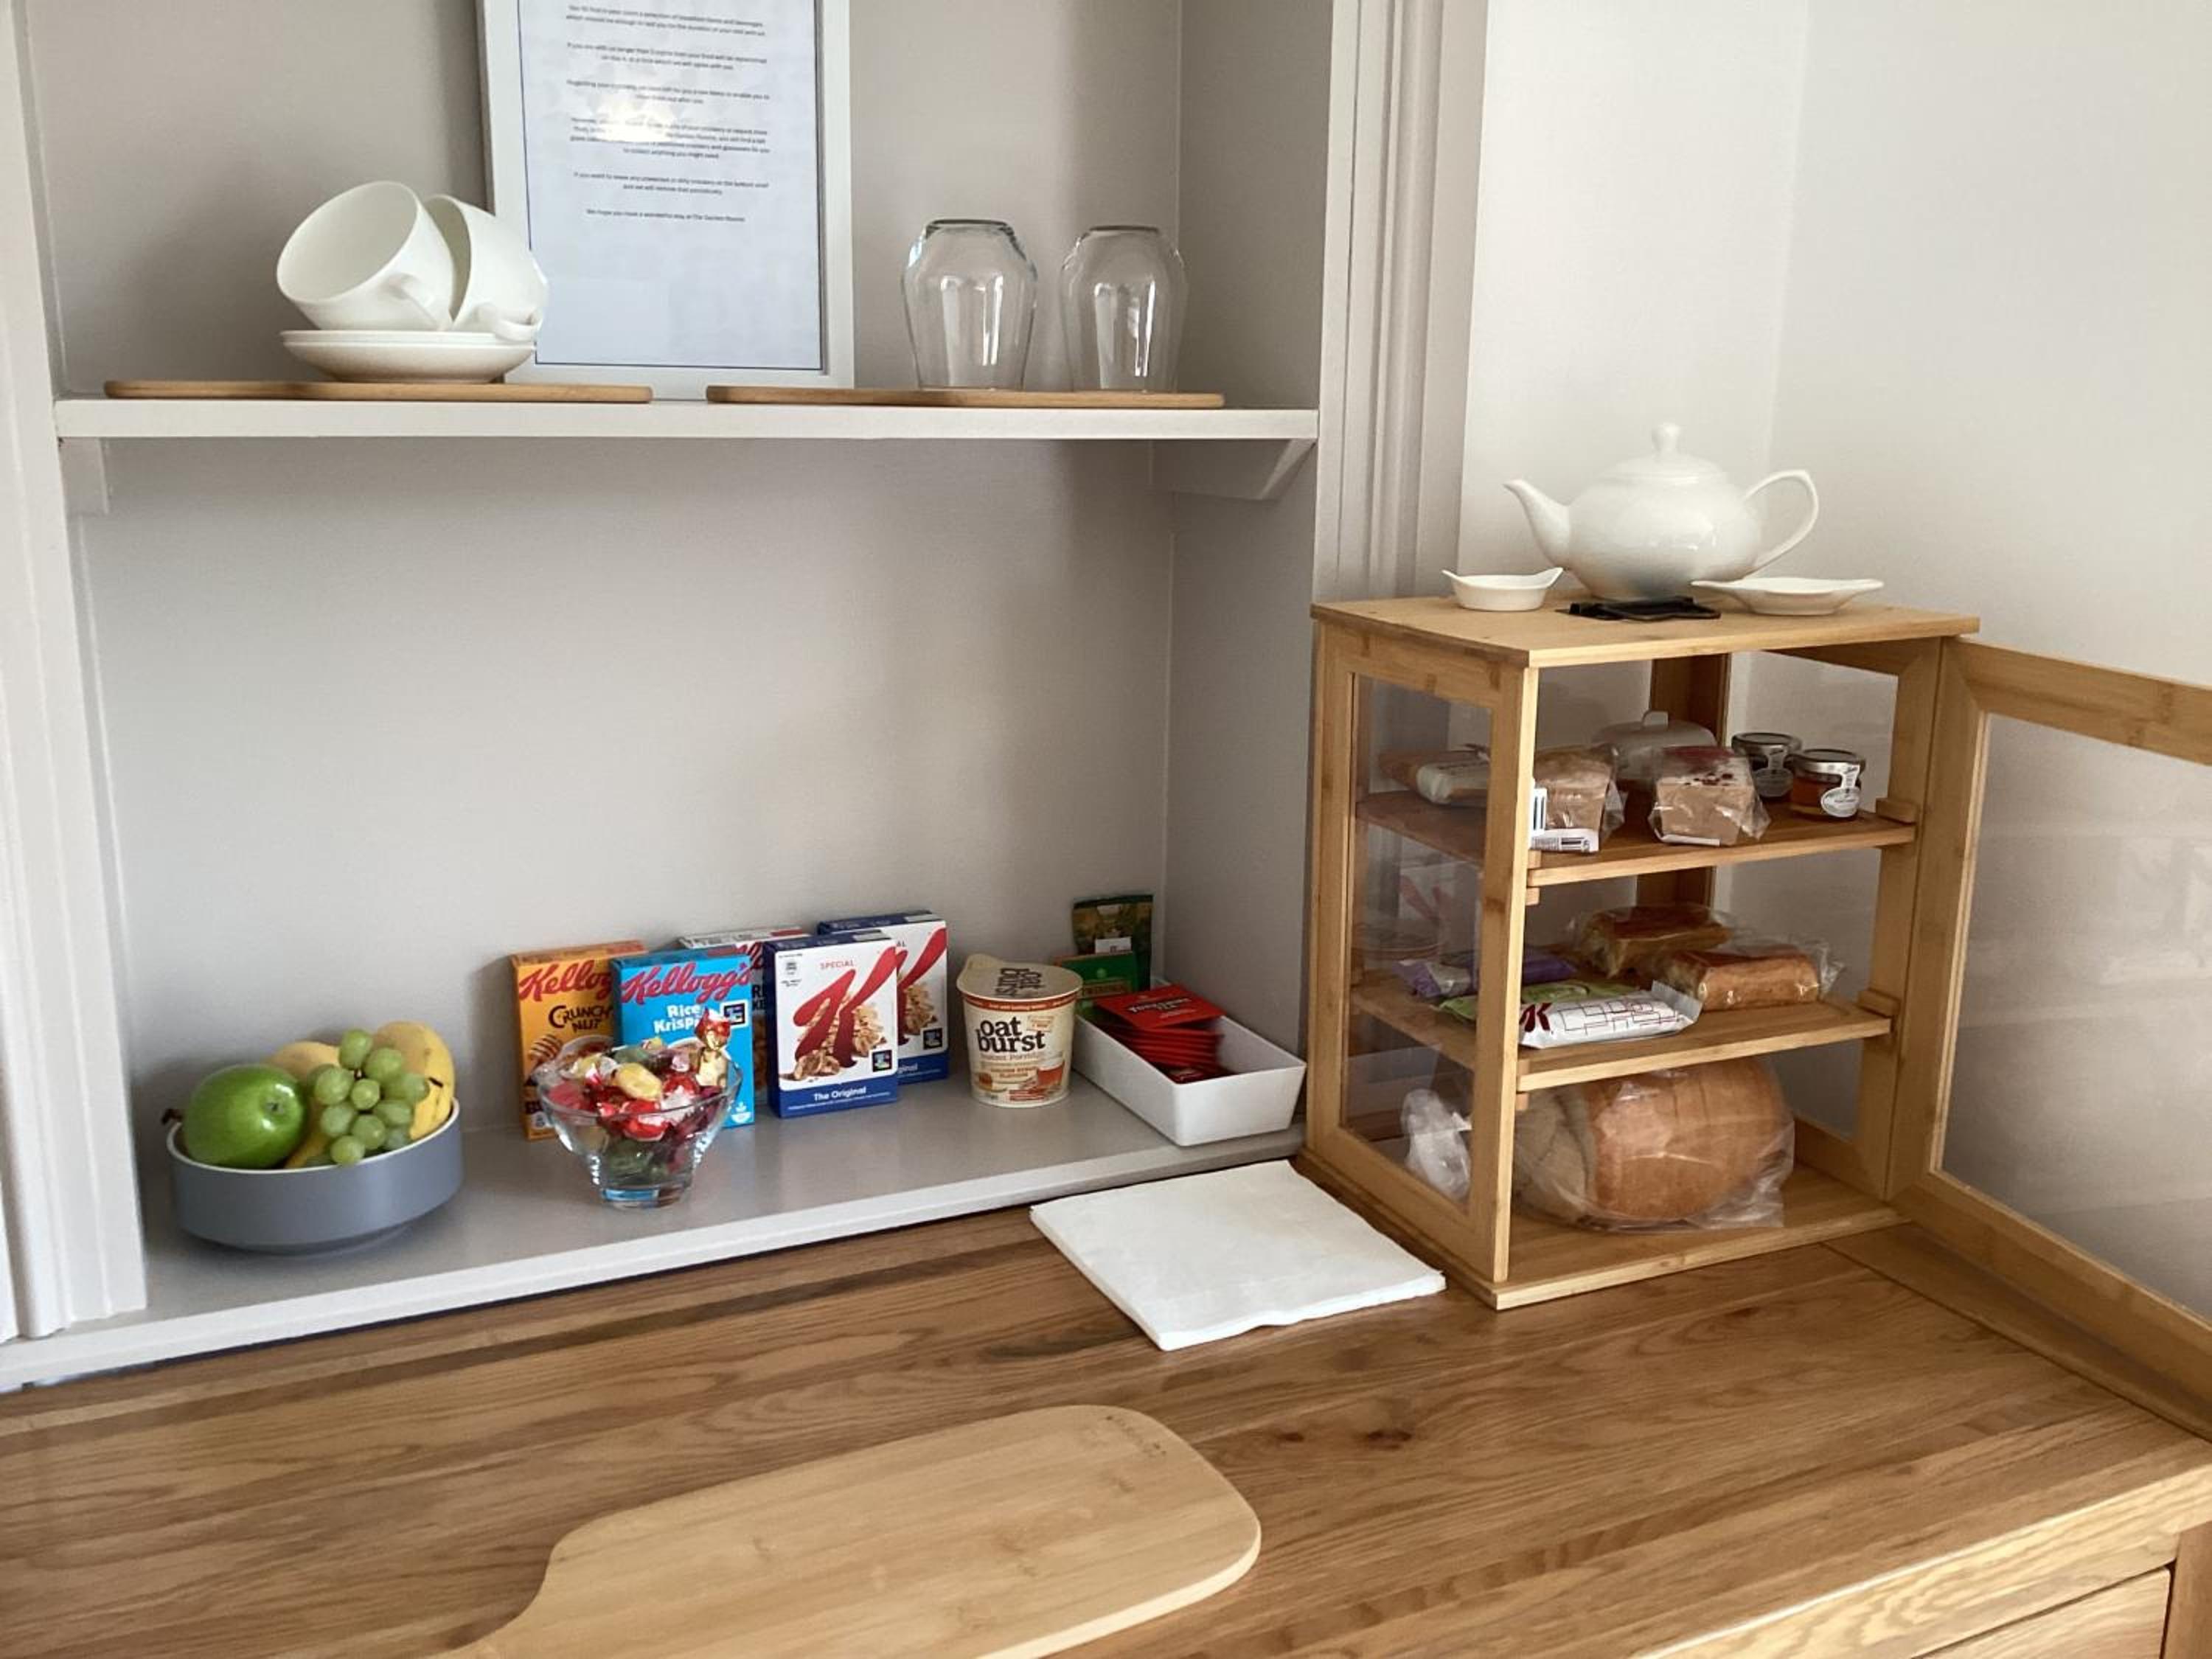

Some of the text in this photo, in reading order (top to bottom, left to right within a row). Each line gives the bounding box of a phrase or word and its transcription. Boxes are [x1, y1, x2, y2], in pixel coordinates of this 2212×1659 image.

[820, 959, 855, 970] SPECIAL
[519, 959, 611, 1001] Kellog
[620, 961, 751, 1004] Kellogg's
[548, 1005, 613, 1029] CRUNCH
[667, 1004, 701, 1018] Rice
[571, 1018, 602, 1033] NUT
[653, 1017, 699, 1033] Krisp
[980, 1016, 1022, 1037] oat
[975, 1028, 1046, 1052] burst
[813, 1086, 867, 1102] The Original
